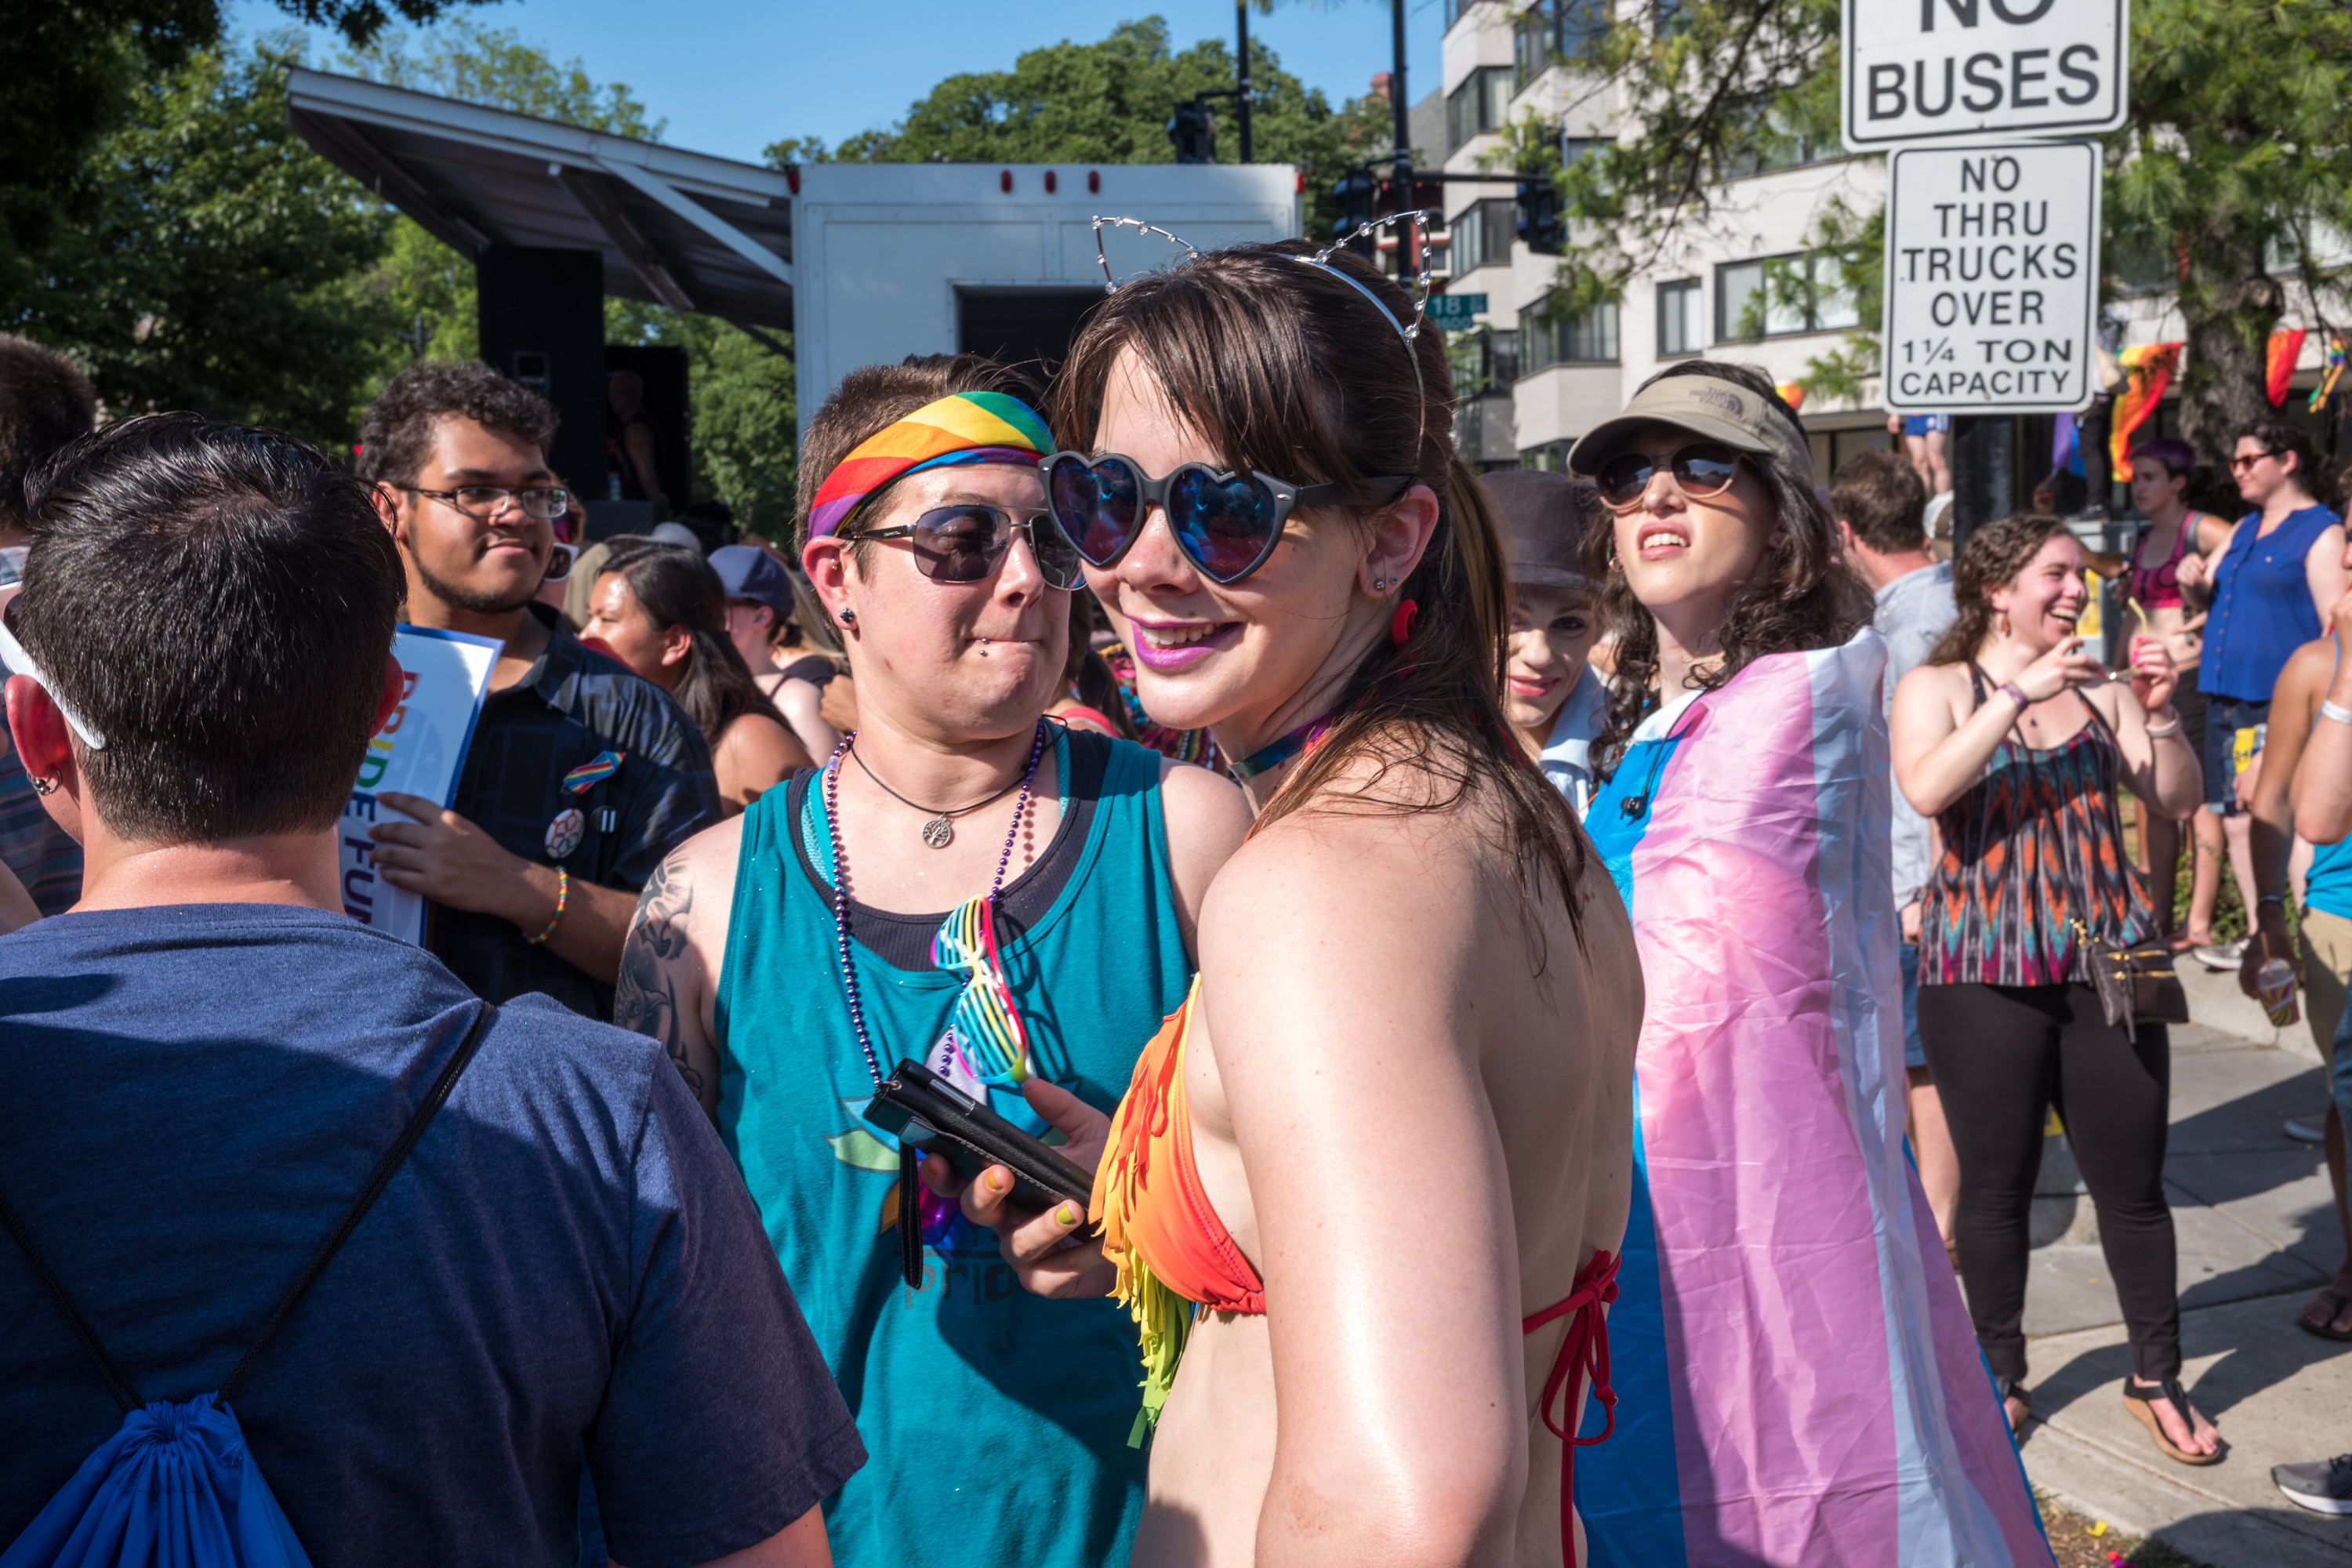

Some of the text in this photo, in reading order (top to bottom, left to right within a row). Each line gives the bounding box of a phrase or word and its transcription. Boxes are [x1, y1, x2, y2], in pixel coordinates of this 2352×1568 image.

[1868, 44, 2100, 121] BUSES
[1962, 157, 2020, 193] NO
[1933, 201, 2048, 238] THRU
[1901, 243, 2077, 281] TRUCKS
[1432, 296, 1461, 315] 18
[1931, 290, 2044, 327] OVER
[1976, 338, 2071, 364] TON
[1900, 370, 2070, 397] CAPACITY
[905, 1261, 1025, 1308] prid
